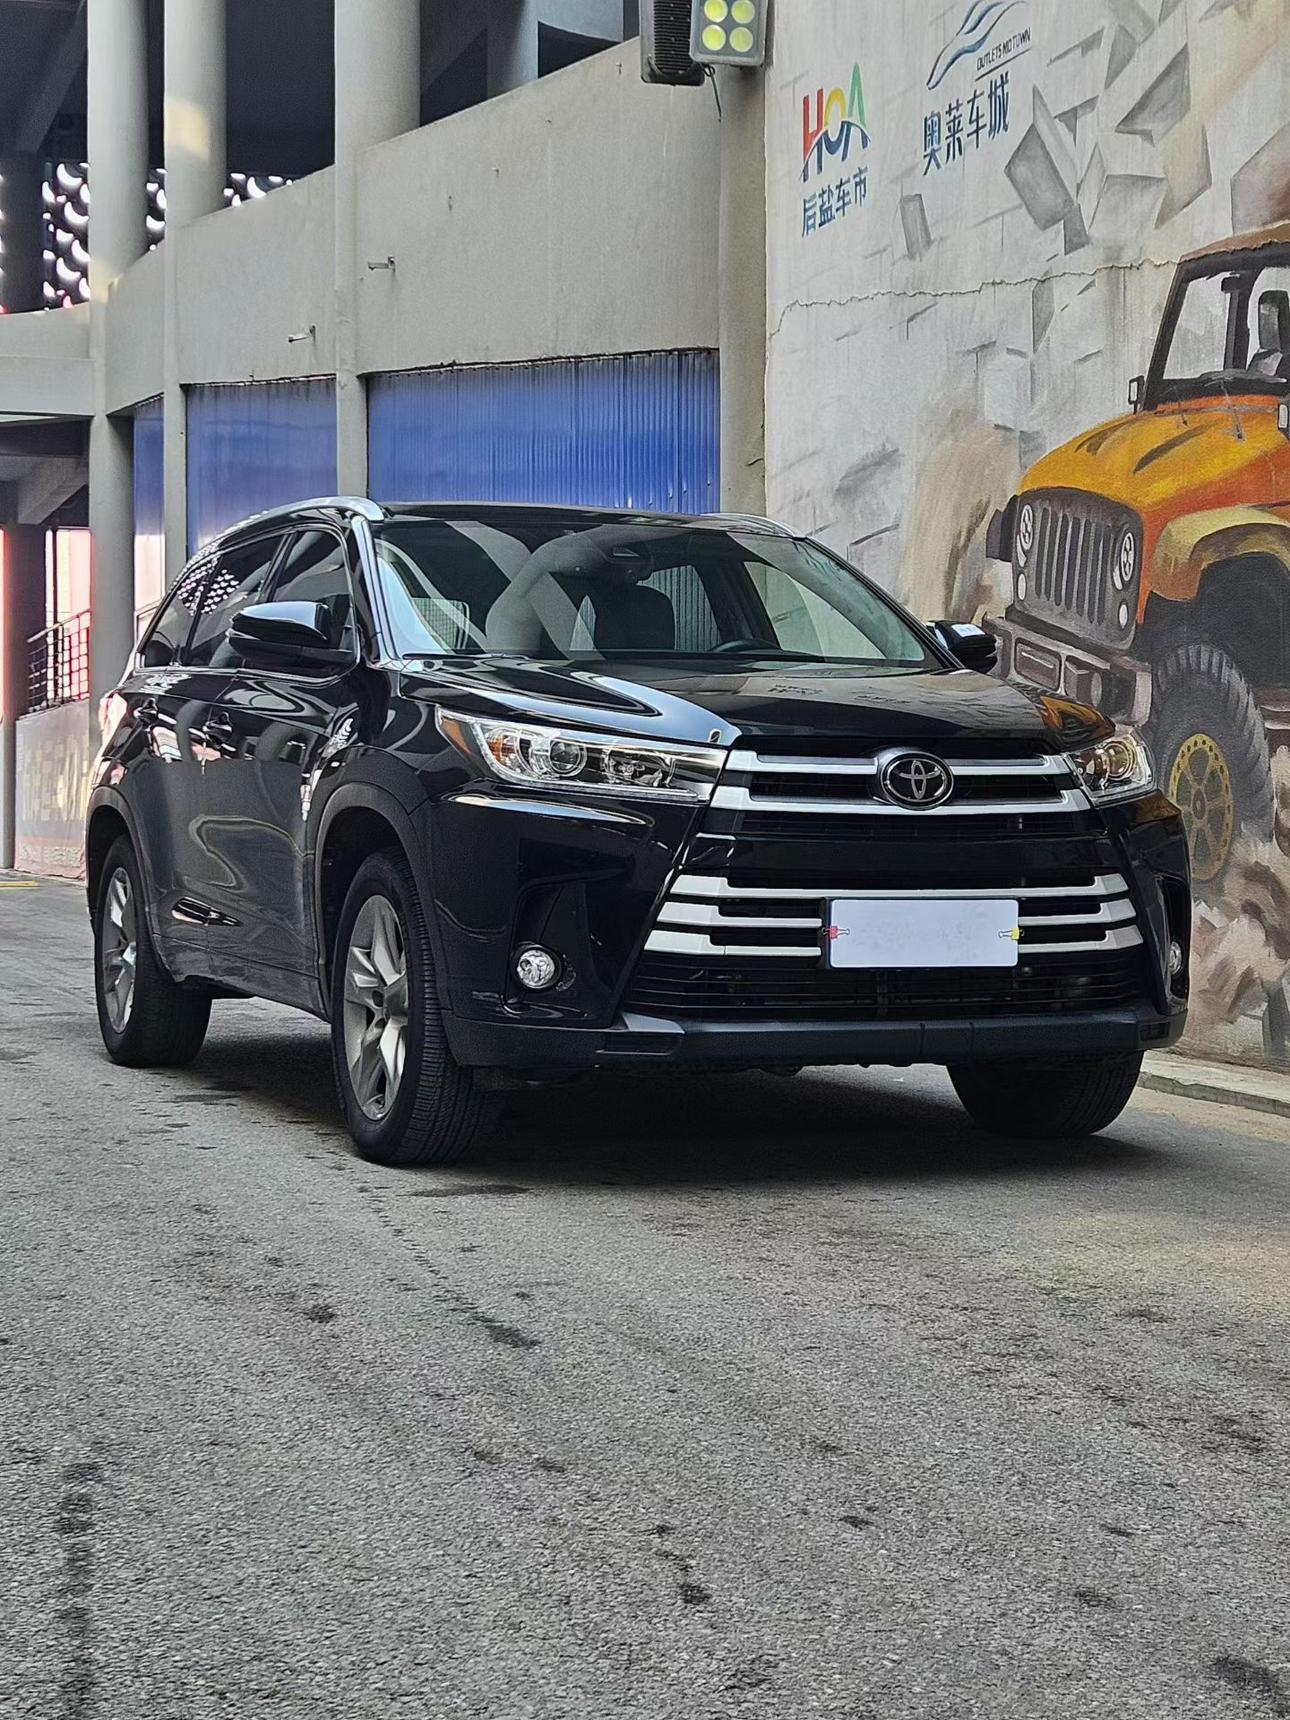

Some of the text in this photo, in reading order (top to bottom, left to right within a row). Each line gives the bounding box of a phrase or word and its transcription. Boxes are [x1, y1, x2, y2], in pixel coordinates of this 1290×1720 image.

[976, 43, 1002, 71] OUTLETS
[923, 71, 1009, 176] 奥莱车城
[801, 165, 869, 238] 后盐车市
